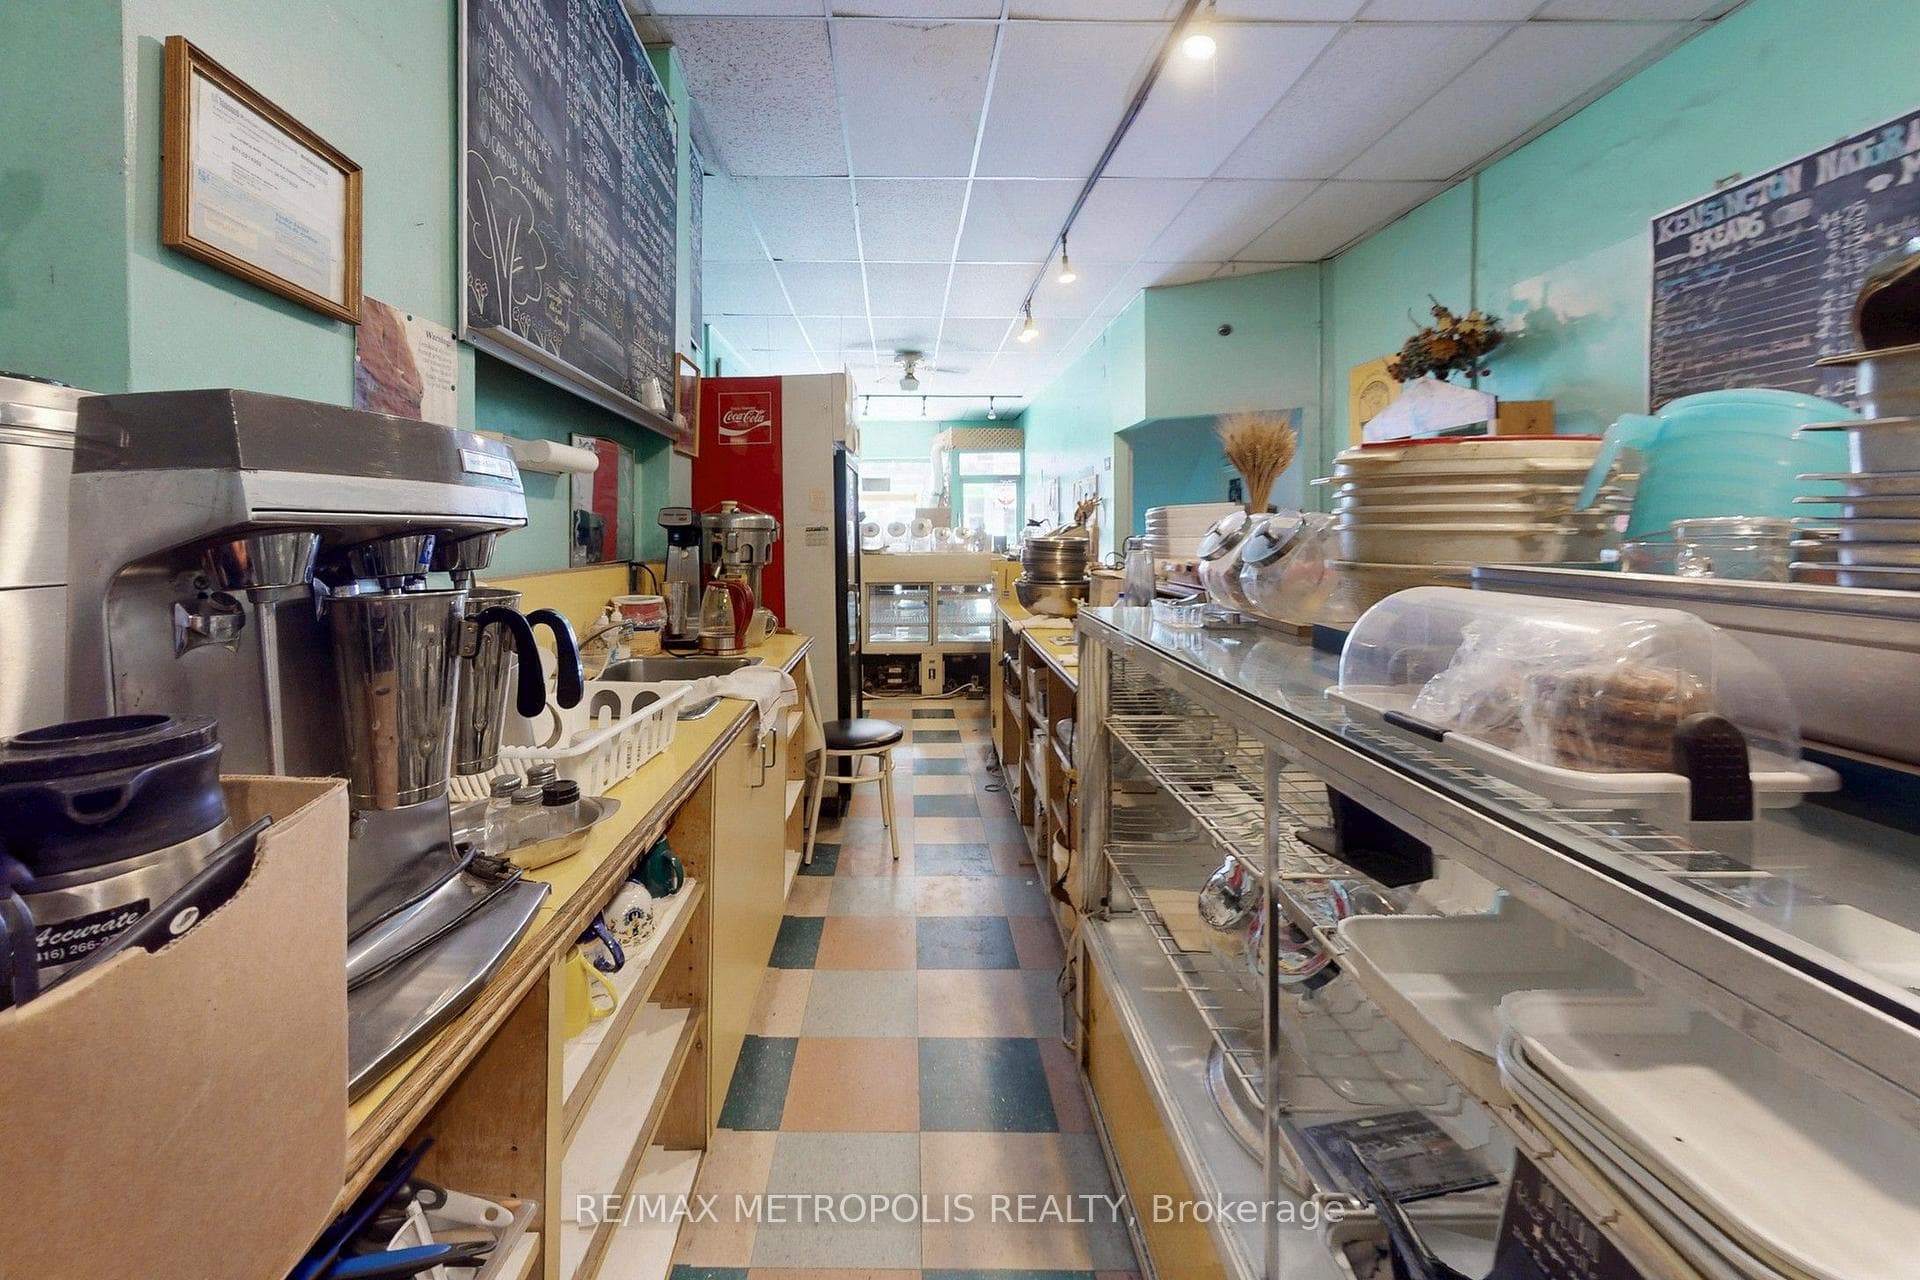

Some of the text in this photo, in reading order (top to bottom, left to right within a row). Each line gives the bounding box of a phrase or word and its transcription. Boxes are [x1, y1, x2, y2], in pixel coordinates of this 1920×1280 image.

[487, 22, 515, 72] APPLE
[488, 47, 533, 115] BLUEBERRY
[488, 73, 516, 118] APPLE
[488, 97, 514, 137] FRUIT
[513, 127, 543, 176] SPIRAL
[491, 136, 519, 176] CAROB
[520, 167, 556, 216] BROWNIE
[1656, 164, 1804, 244] KENSINGTON
[1687, 210, 1766, 258] BREADS
[35, 911, 140, 948] Accurate
